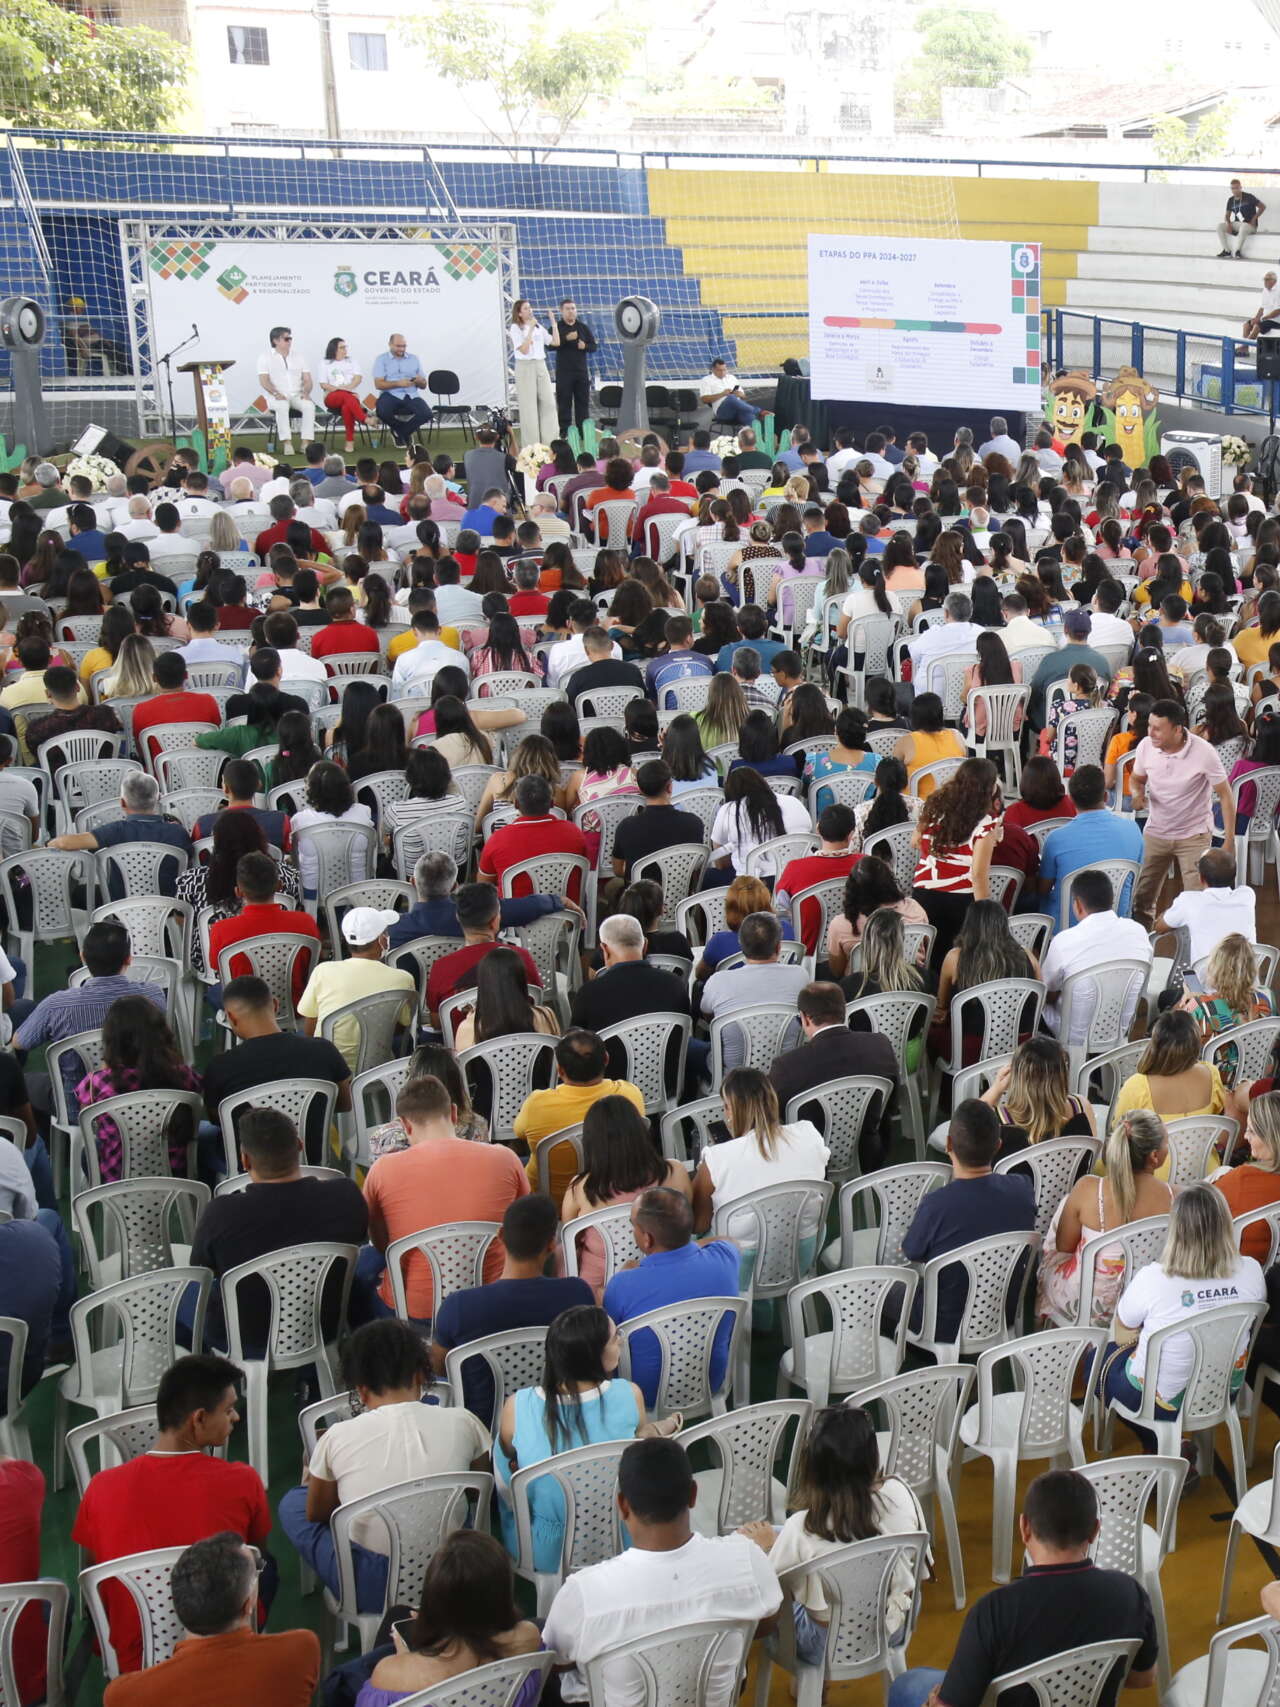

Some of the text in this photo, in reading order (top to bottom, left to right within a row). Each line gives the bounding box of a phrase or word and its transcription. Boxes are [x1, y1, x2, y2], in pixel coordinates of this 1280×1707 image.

[819, 249, 917, 262] ETAPAS DO PPA 2024-2027
[363, 266, 440, 286] CEARÁ
[1197, 1286, 1239, 1299] CEARÁ
